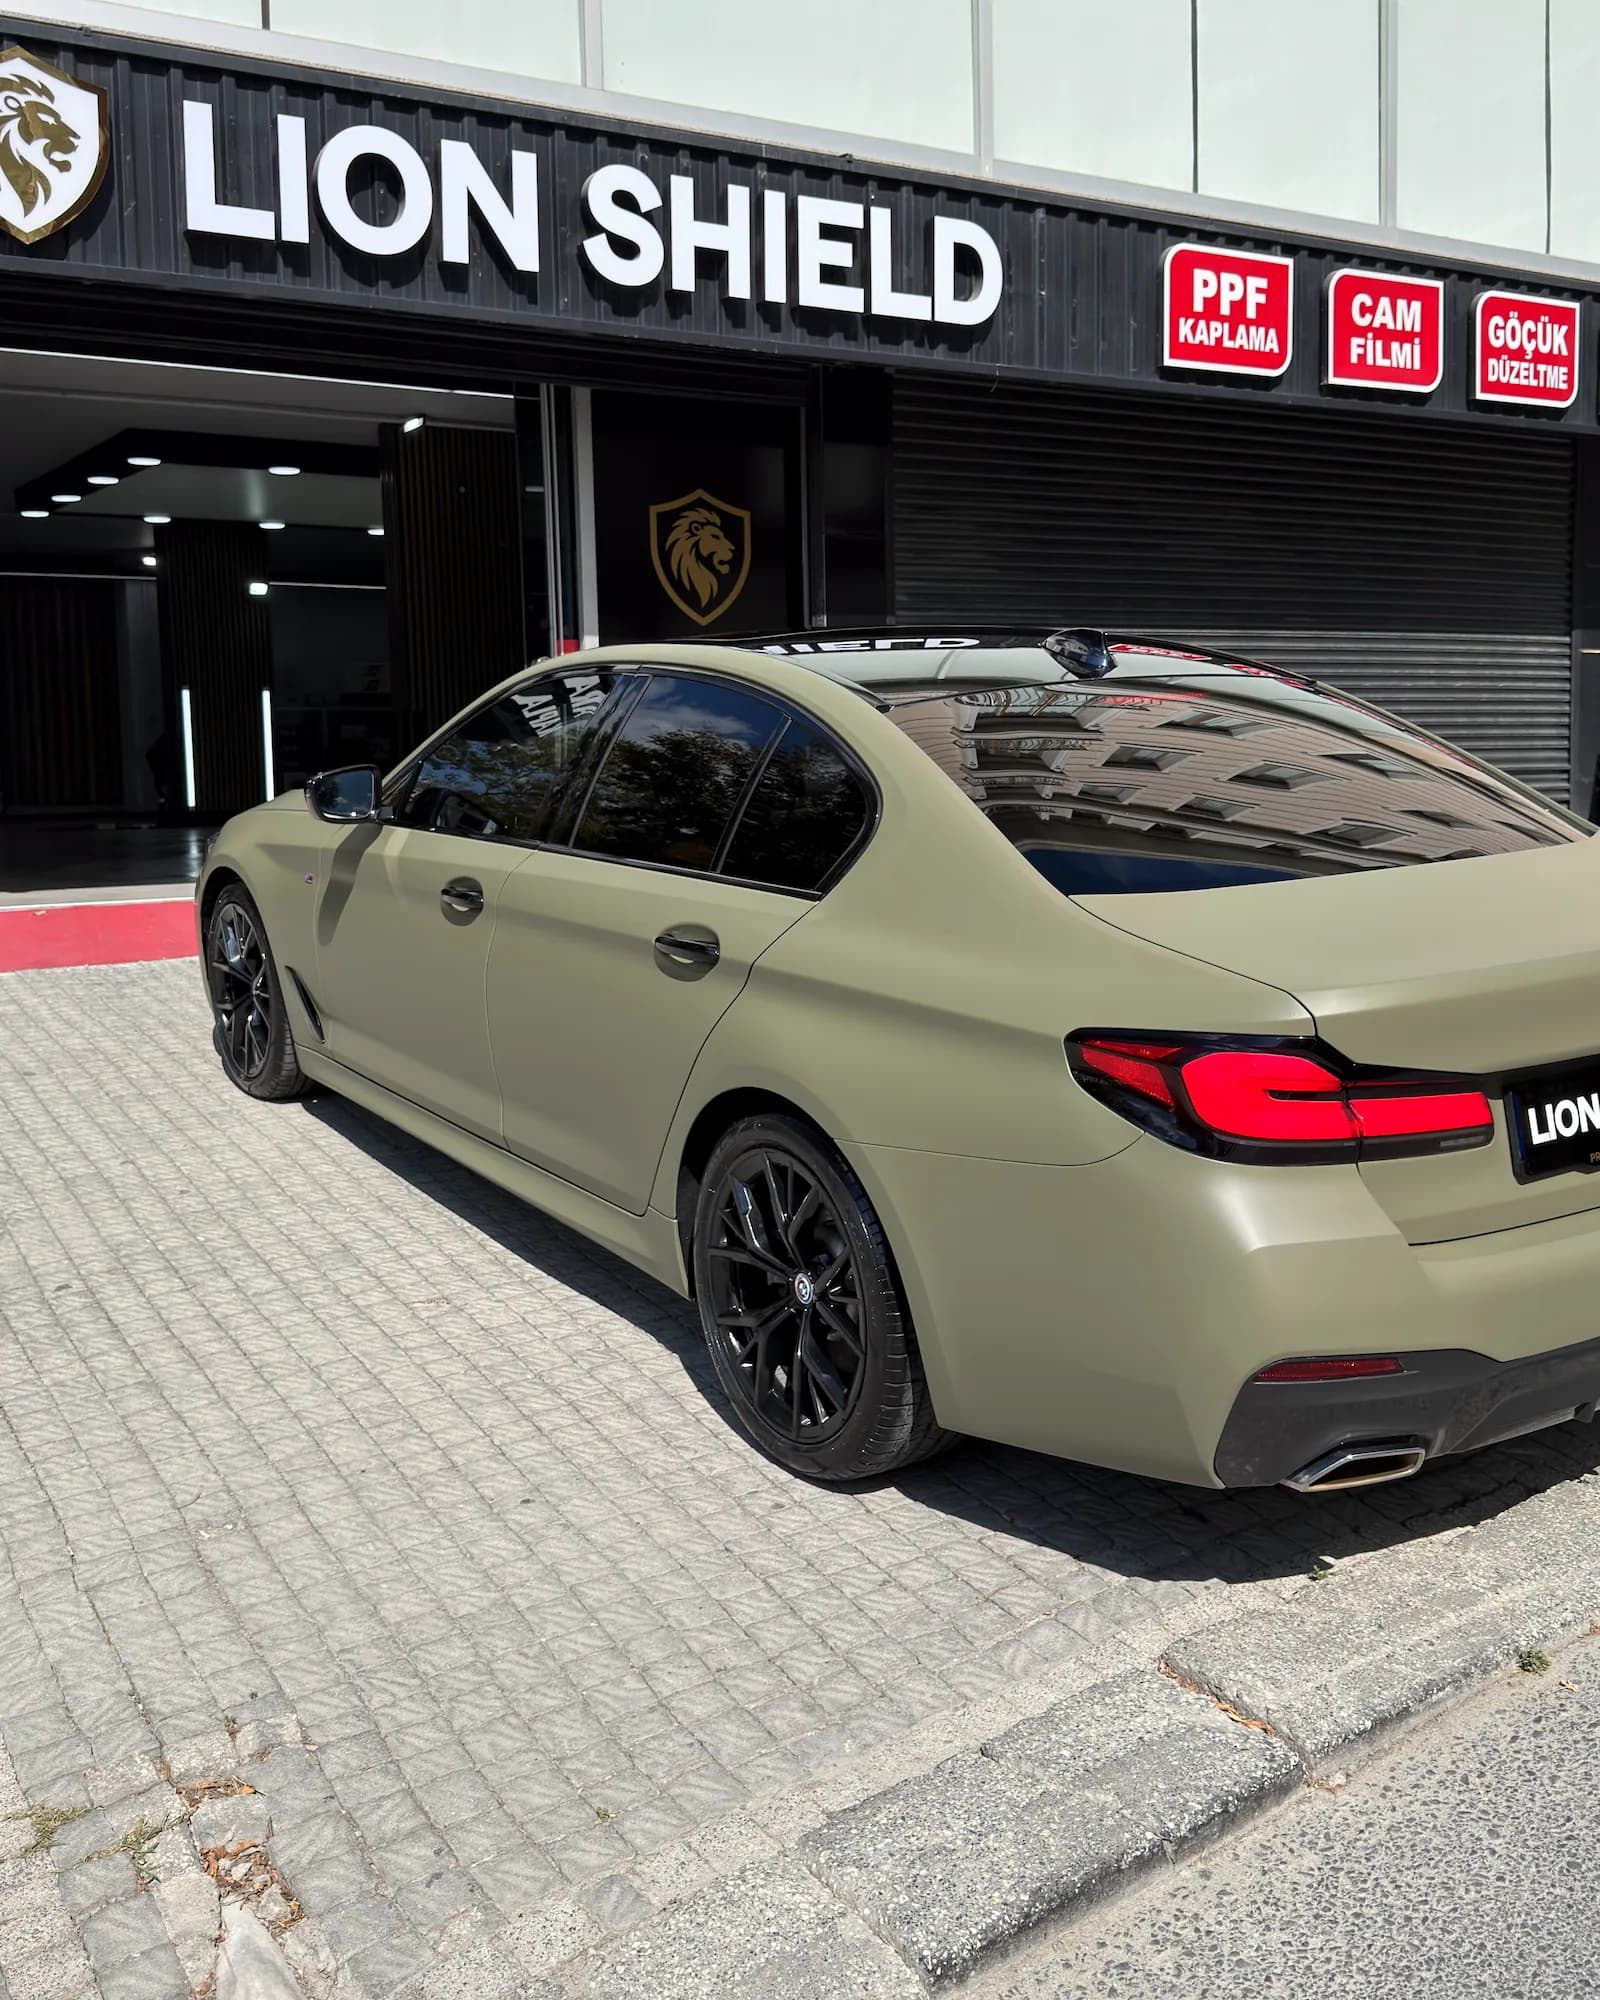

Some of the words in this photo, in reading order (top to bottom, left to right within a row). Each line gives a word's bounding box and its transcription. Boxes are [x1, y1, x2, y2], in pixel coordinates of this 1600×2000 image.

[183, 100, 540, 273] LION
[580, 164, 1003, 326] SHIELD
[1192, 268, 1268, 319] PPF
[1351, 293, 1422, 333] CAM
[1178, 317, 1280, 354] KAPLAMA
[1350, 332, 1421, 371] FİLMİ
[1487, 311, 1569, 359] GÖÇÜK
[1487, 354, 1569, 390] DÜZELTME
[1527, 1092, 1600, 1145] LION
